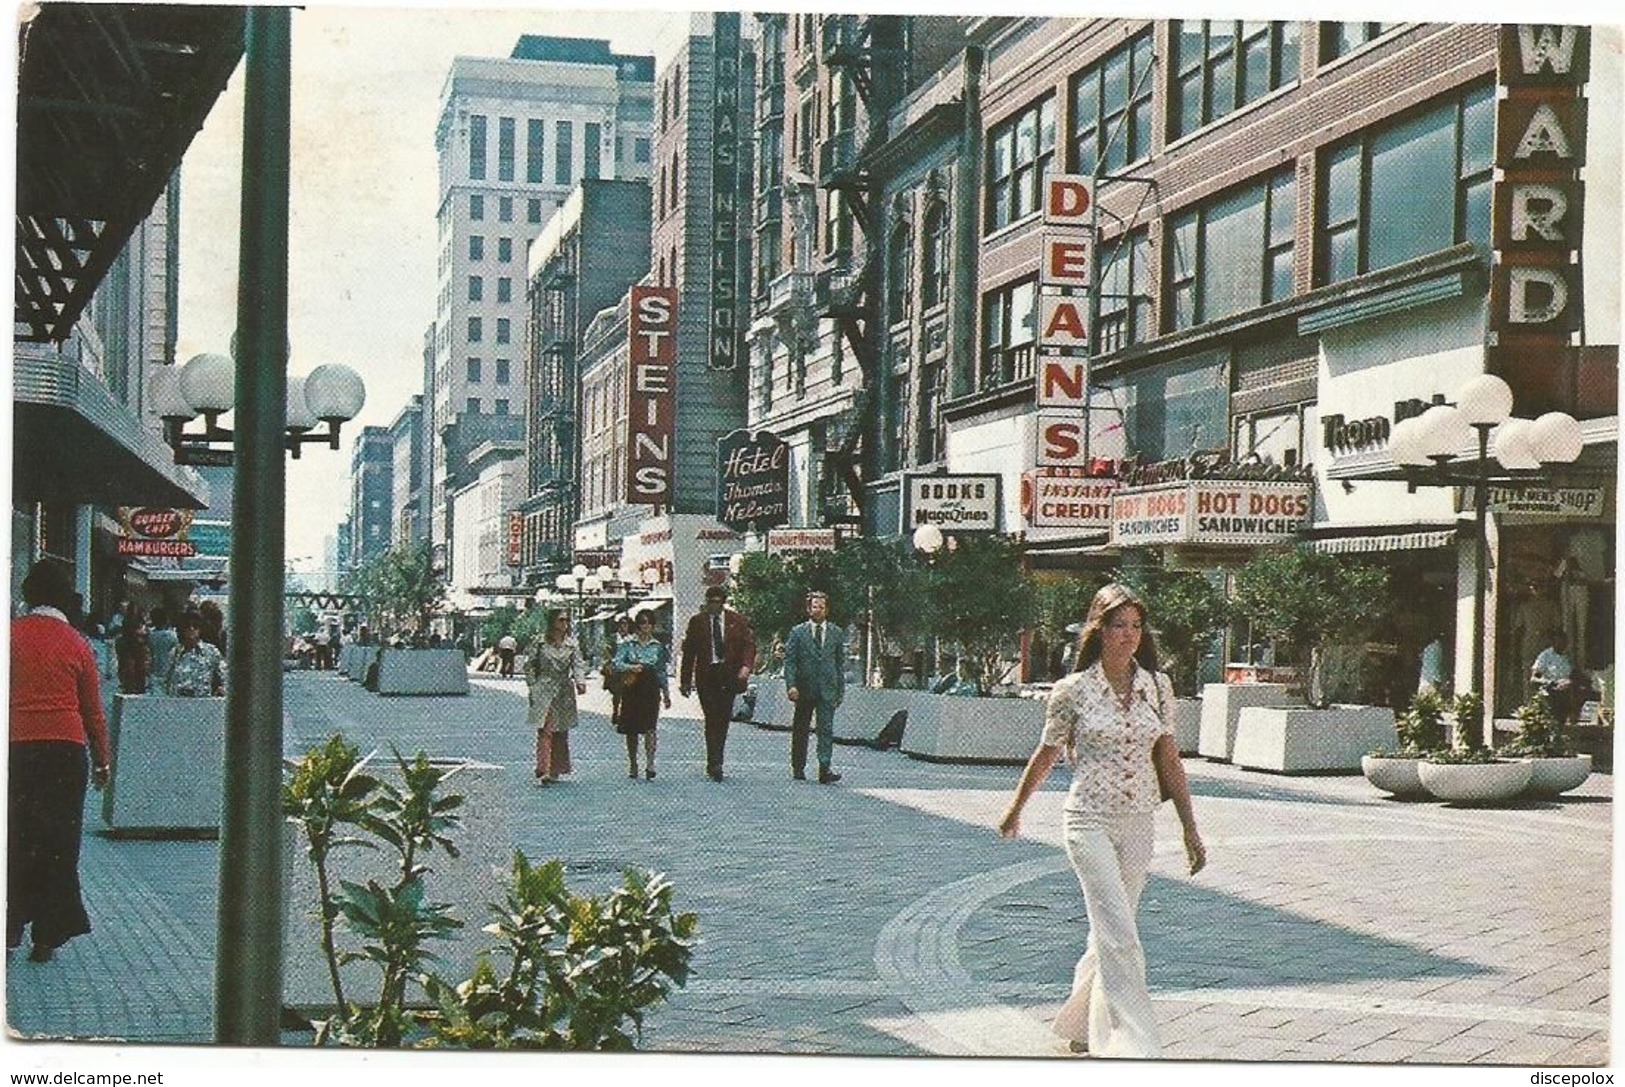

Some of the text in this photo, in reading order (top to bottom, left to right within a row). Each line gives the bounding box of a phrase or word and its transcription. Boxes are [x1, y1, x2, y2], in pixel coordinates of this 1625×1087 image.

[1508, 26, 1579, 324] WARD
[715, 193, 733, 357] NELSON
[1045, 181, 1090, 460] DEANS
[635, 296, 671, 494] STEINS
[723, 443, 785, 478] Hotel
[921, 483, 985, 499] BOOKS
[1043, 484, 1113, 498] INSTANT
[1560, 491, 1597, 512] SHOP
[724, 501, 784, 521] Nelson
[1042, 502, 1111, 519] CREDIT
[1115, 491, 1187, 520] HOT DOGS
[1198, 492, 1309, 516] HOT DOGS
[1119, 517, 1180, 536] SANDWICHES
[118, 540, 194, 556] HAMBURGERS
